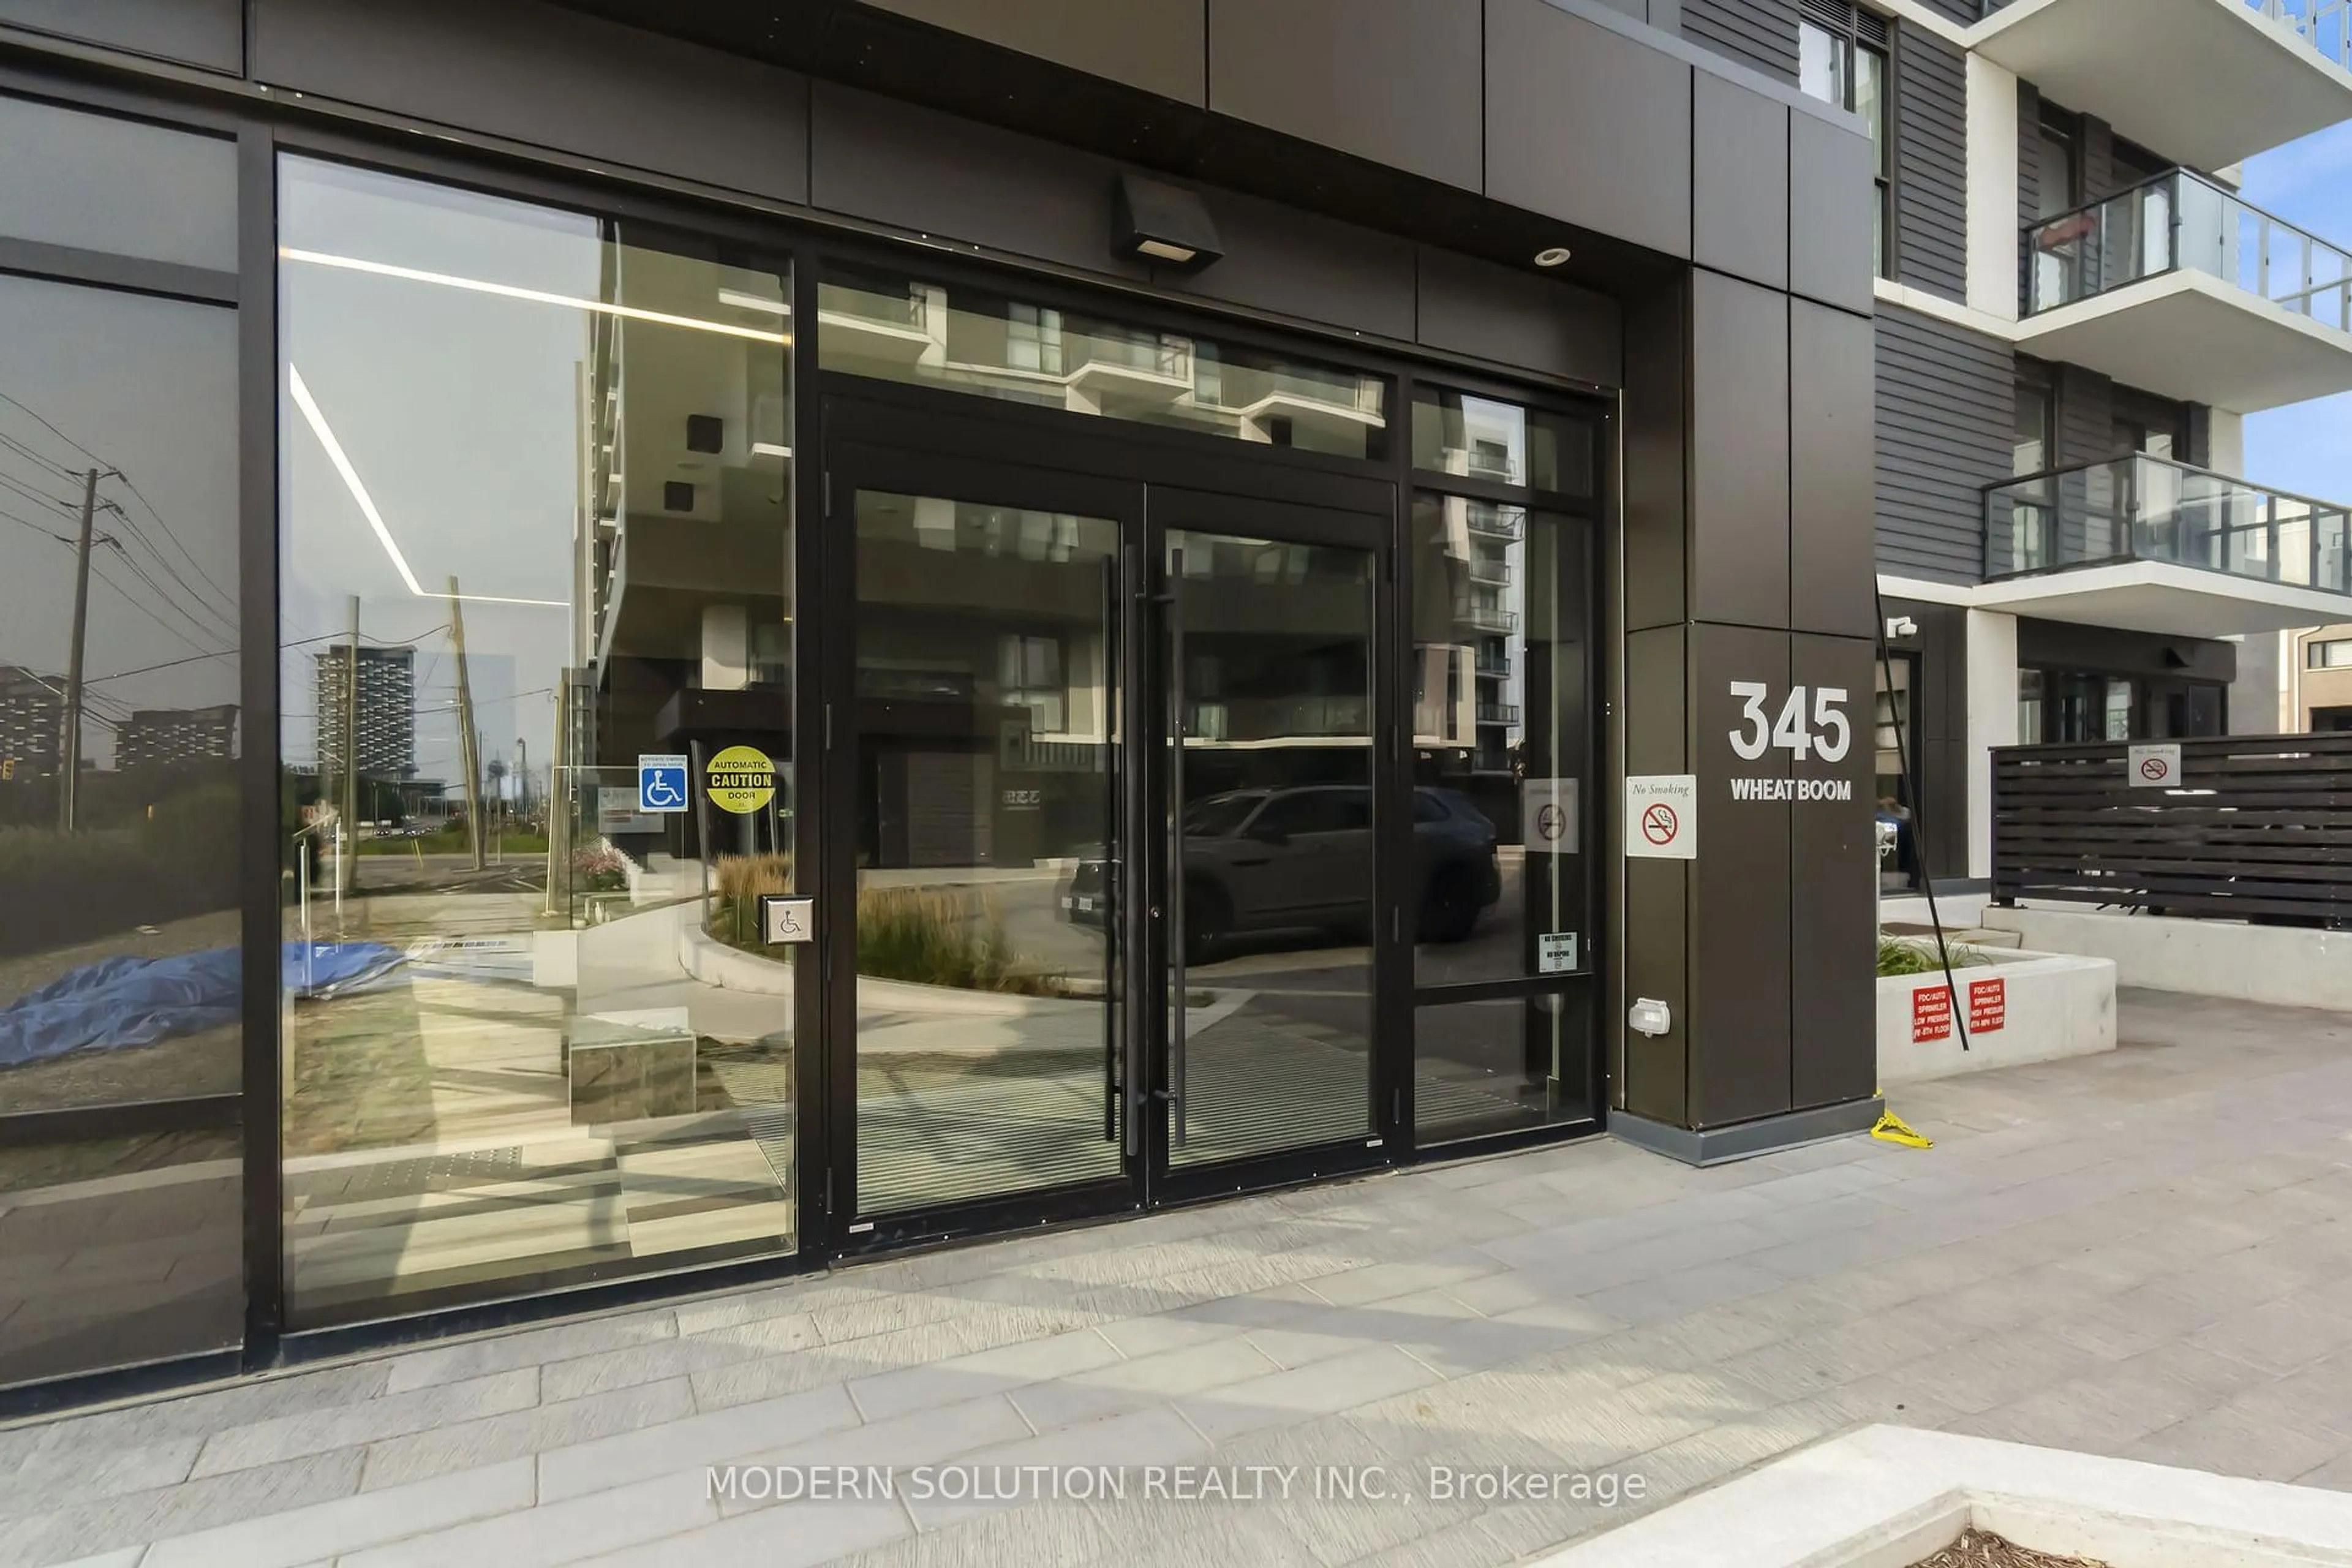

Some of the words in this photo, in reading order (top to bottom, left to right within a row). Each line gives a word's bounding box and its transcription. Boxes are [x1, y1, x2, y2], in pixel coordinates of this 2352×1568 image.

[1728, 680, 1850, 763] 345
[714, 760, 767, 770] AUTOMATIC
[711, 774, 772, 788] CAUTION
[728, 791, 756, 800] DOOR
[1632, 783, 1646, 795] No
[1649, 783, 1689, 797] Smoking
[1731, 778, 1793, 801] WHEAT
[1798, 780, 1852, 801] BOOM
